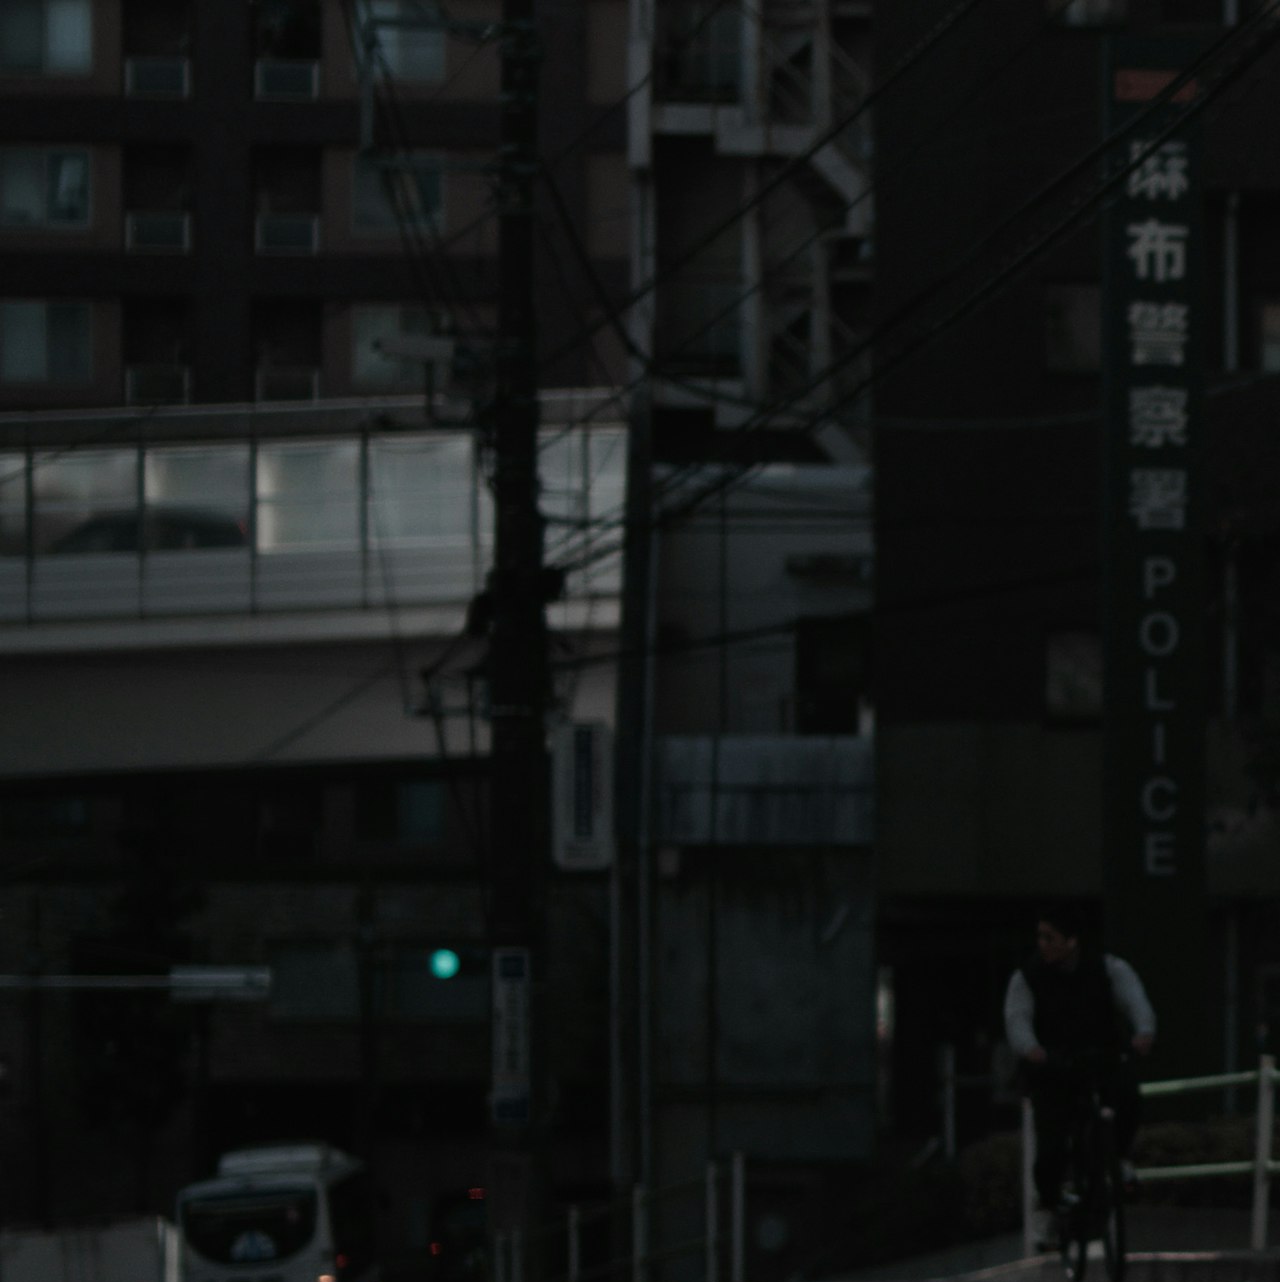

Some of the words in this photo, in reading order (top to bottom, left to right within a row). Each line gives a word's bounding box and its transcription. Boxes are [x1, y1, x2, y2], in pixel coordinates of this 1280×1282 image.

[1125, 139, 1190, 533] 麻布警察署
[1137, 554, 1180, 876] POLICE
